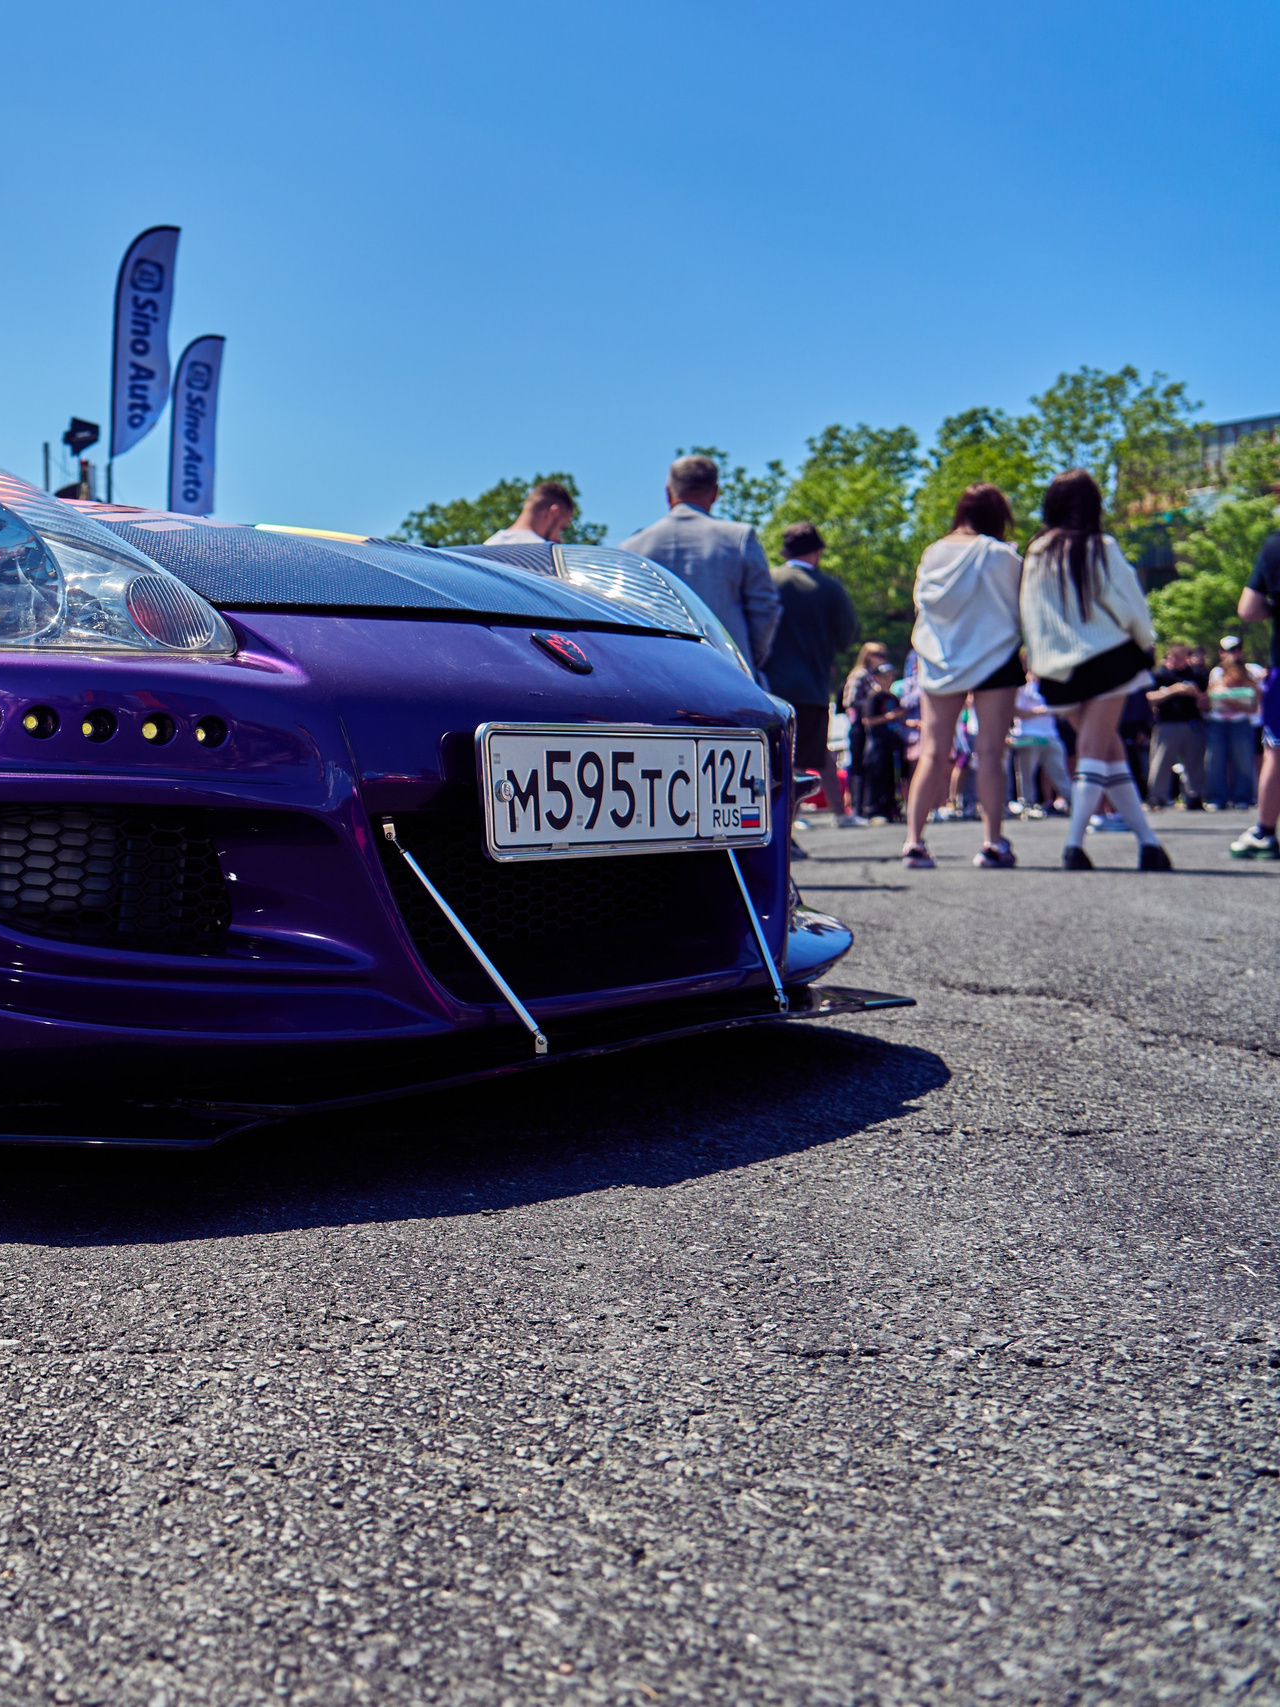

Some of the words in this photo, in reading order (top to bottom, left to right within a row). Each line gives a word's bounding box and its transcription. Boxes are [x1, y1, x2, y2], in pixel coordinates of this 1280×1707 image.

[129, 295, 159, 357] Sino
[127, 361, 156, 430] Auto
[183, 391, 207, 446] Sino
[181, 448, 204, 504] Auto
[701, 748, 756, 805] 124
[712, 807, 740, 829] RUS
